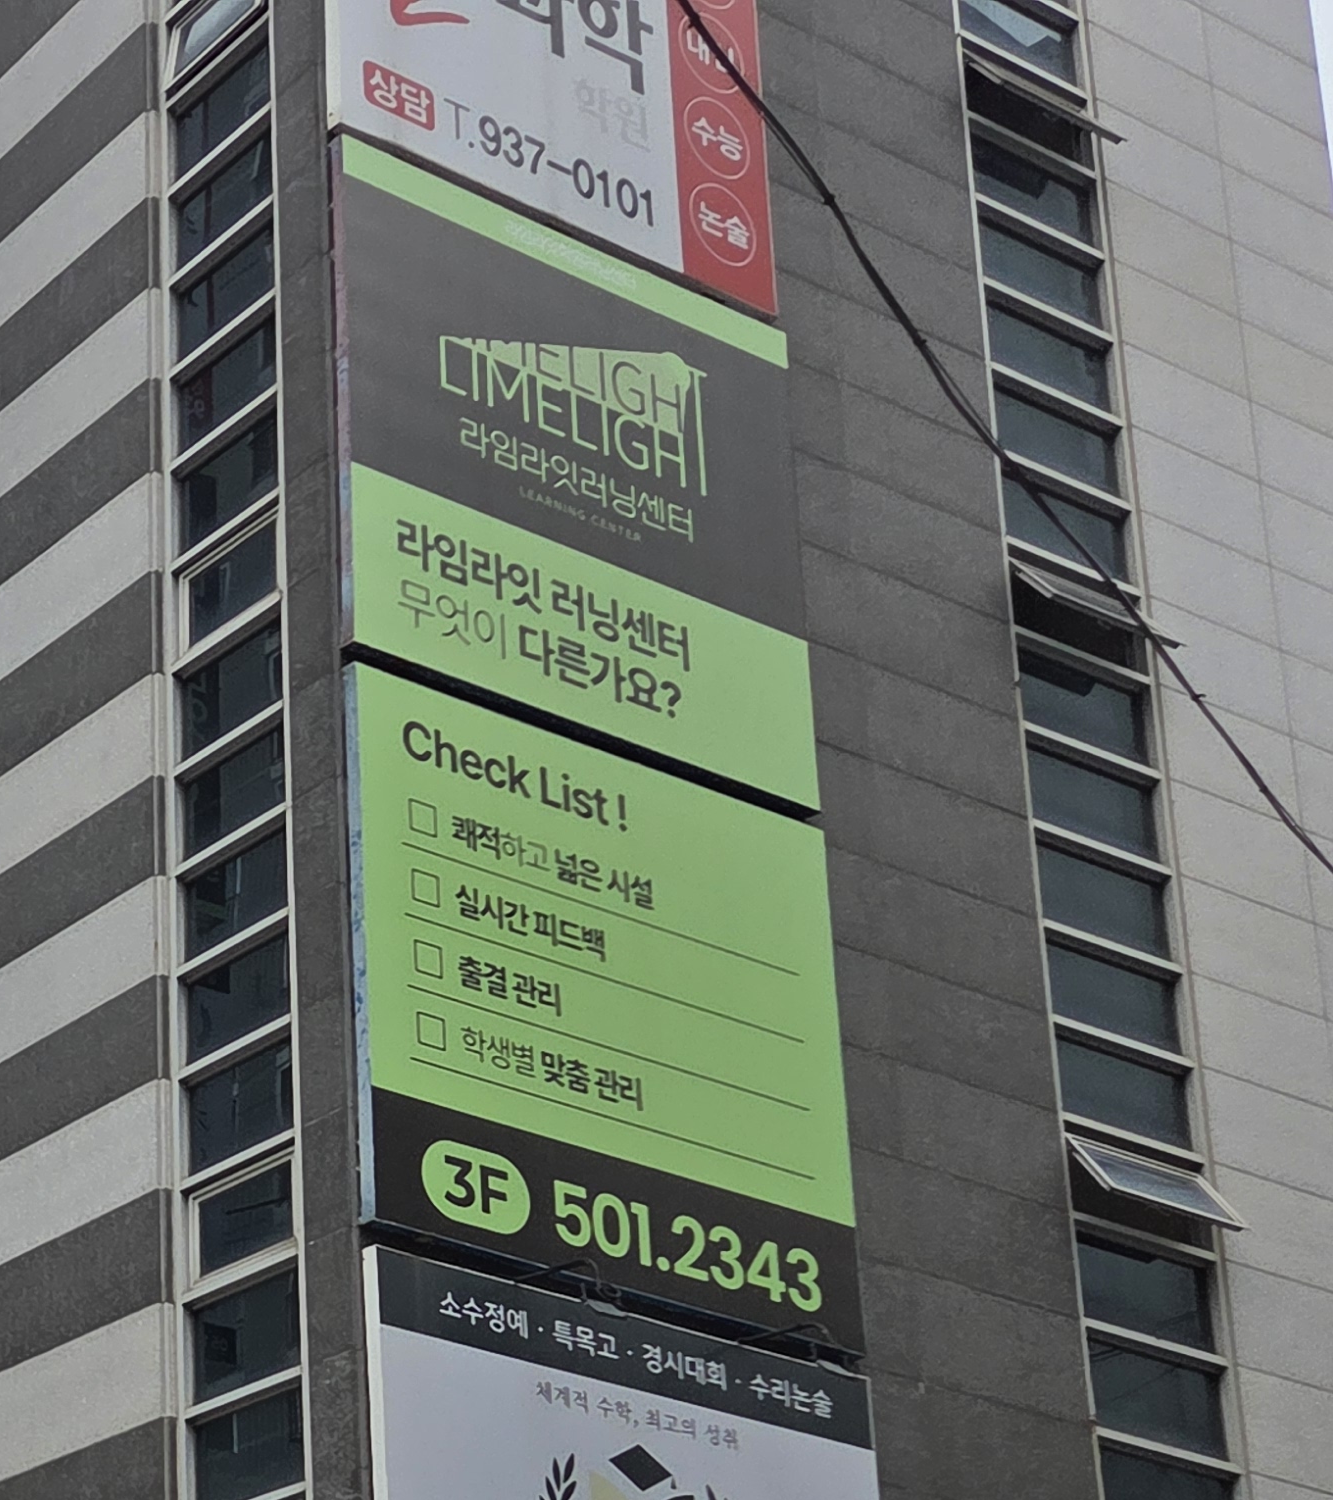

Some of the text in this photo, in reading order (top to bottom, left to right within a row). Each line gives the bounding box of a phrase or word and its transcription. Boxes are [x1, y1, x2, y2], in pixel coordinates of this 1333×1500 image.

[371, 69, 431, 125] 상담
[444, 98, 654, 227] T.937-0101
[692, 116, 743, 162] 수능
[699, 201, 749, 250] 논술
[460, 417, 695, 542] 라임라잇러닝센터
[396, 519, 691, 672] 라임라잇 러닝센터
[397, 579, 683, 718] 무엇이 다른가요?
[401, 721, 531, 799] Check
[452, 817, 655, 910] 쾌적하고 넓은 시설
[455, 885, 608, 962] 실시간 피드백
[459, 956, 562, 1016] 출결 관리
[461, 1027, 644, 1111] 학생별 맞춤 관리
[443, 1154, 509, 1213] 3F
[554, 1178, 822, 1312] 501.2343
[440, 1291, 834, 1419] 소수정예 특목고 경시대회 수리논술
[645, 1408, 697, 1440] 최고의
